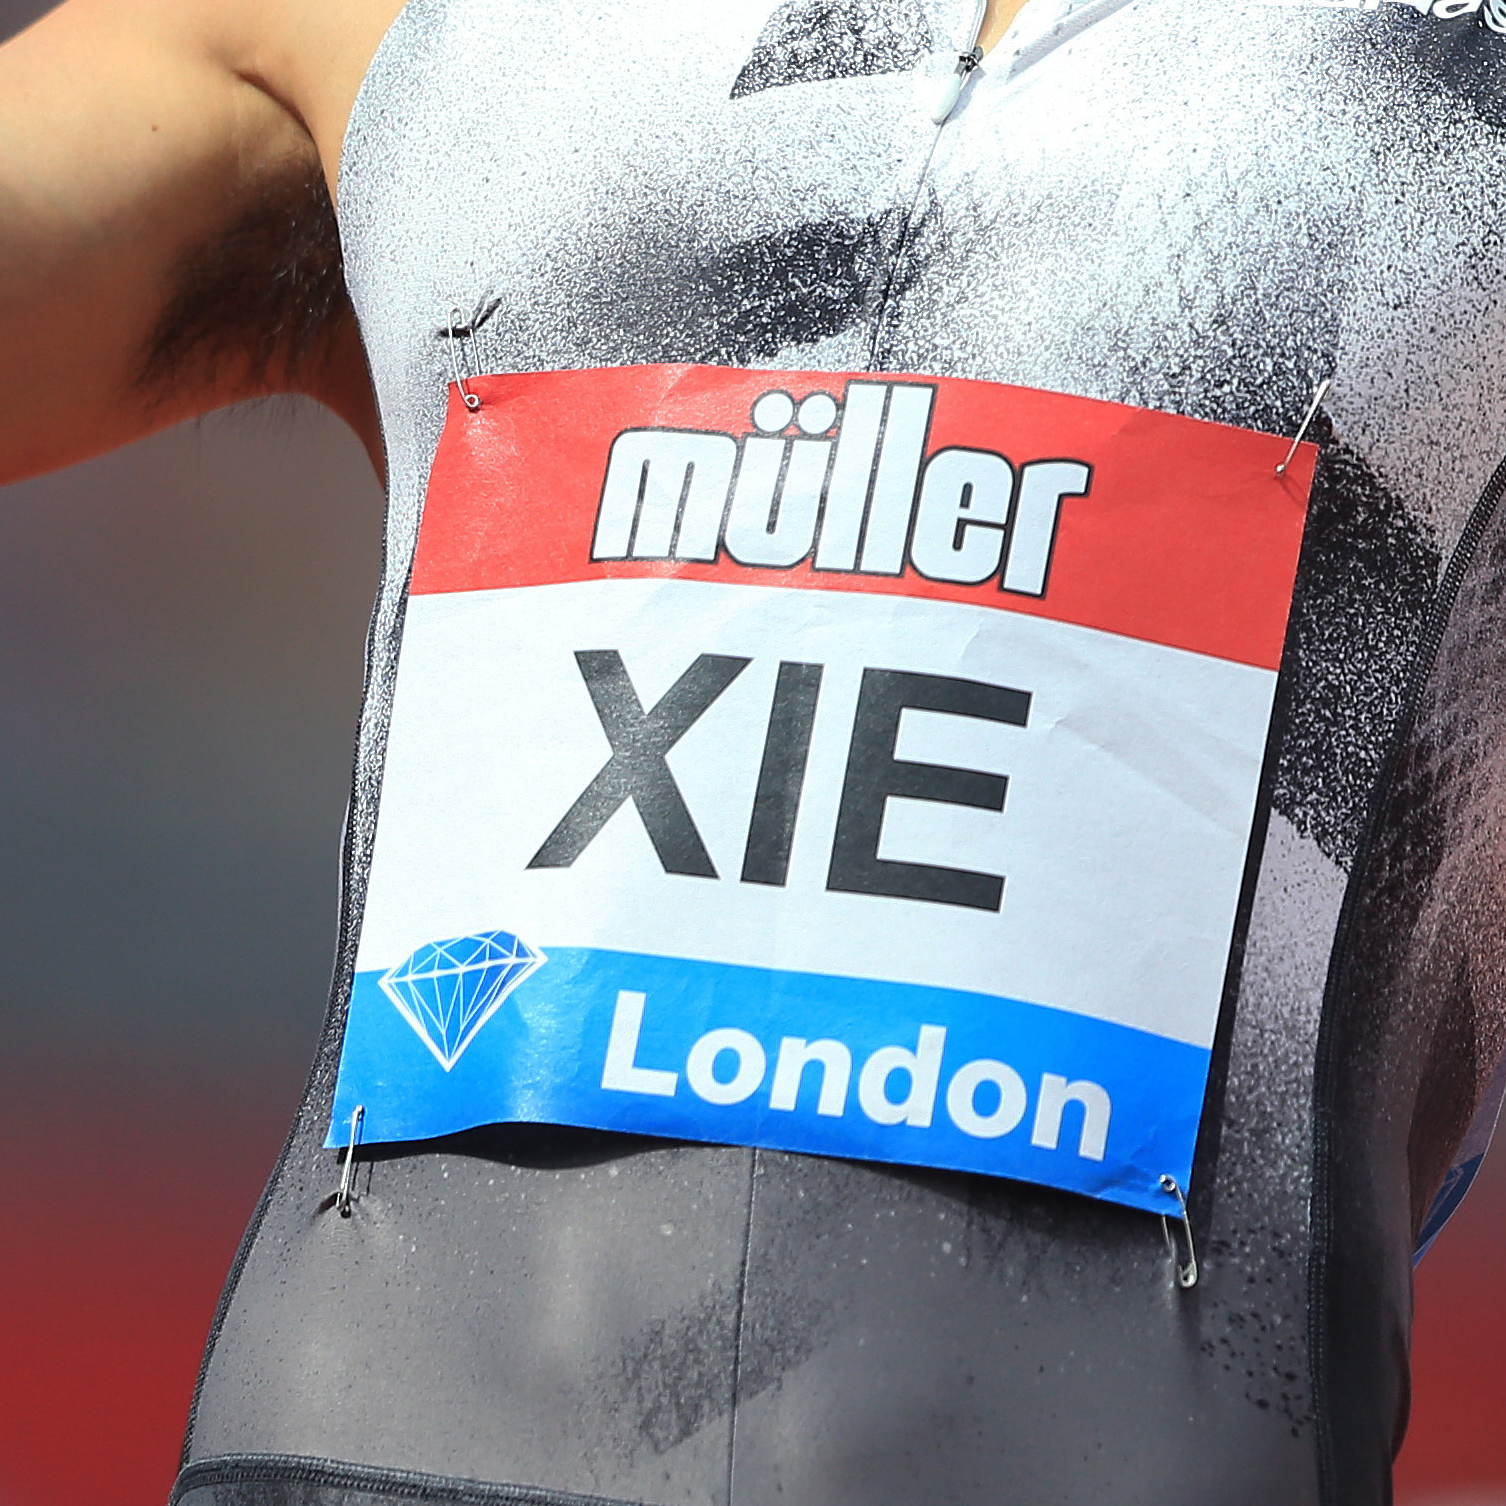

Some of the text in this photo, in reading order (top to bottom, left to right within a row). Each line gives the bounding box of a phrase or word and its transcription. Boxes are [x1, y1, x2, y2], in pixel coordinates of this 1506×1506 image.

[589, 381, 1091, 598] müller
[525, 648, 1033, 912] XIE
[600, 989, 1113, 1160] London
